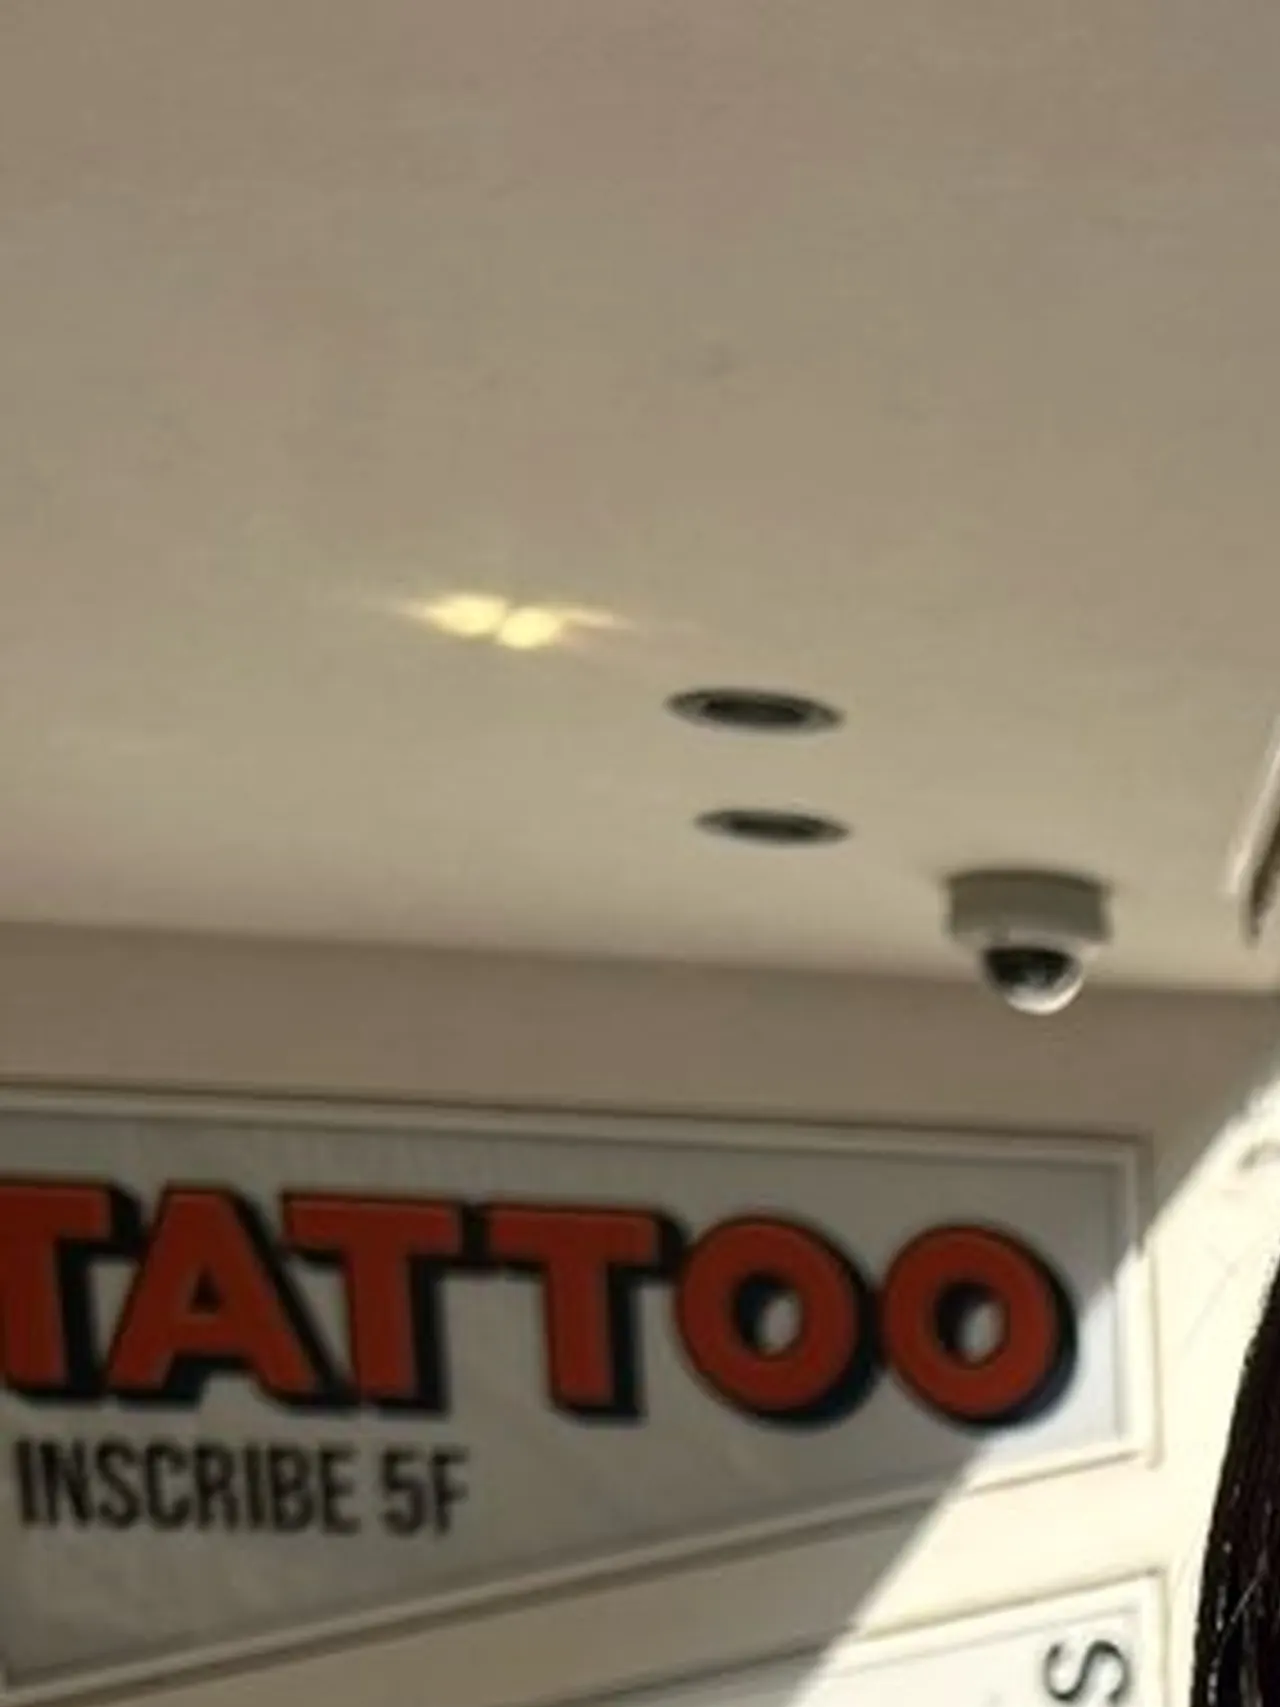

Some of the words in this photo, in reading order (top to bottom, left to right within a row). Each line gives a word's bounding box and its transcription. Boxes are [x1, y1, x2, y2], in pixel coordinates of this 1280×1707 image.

[0, 1175, 1076, 1428] TATTOO
[13, 1438, 361, 1536] INSCRIBE
[379, 1446, 468, 1537] 5F
